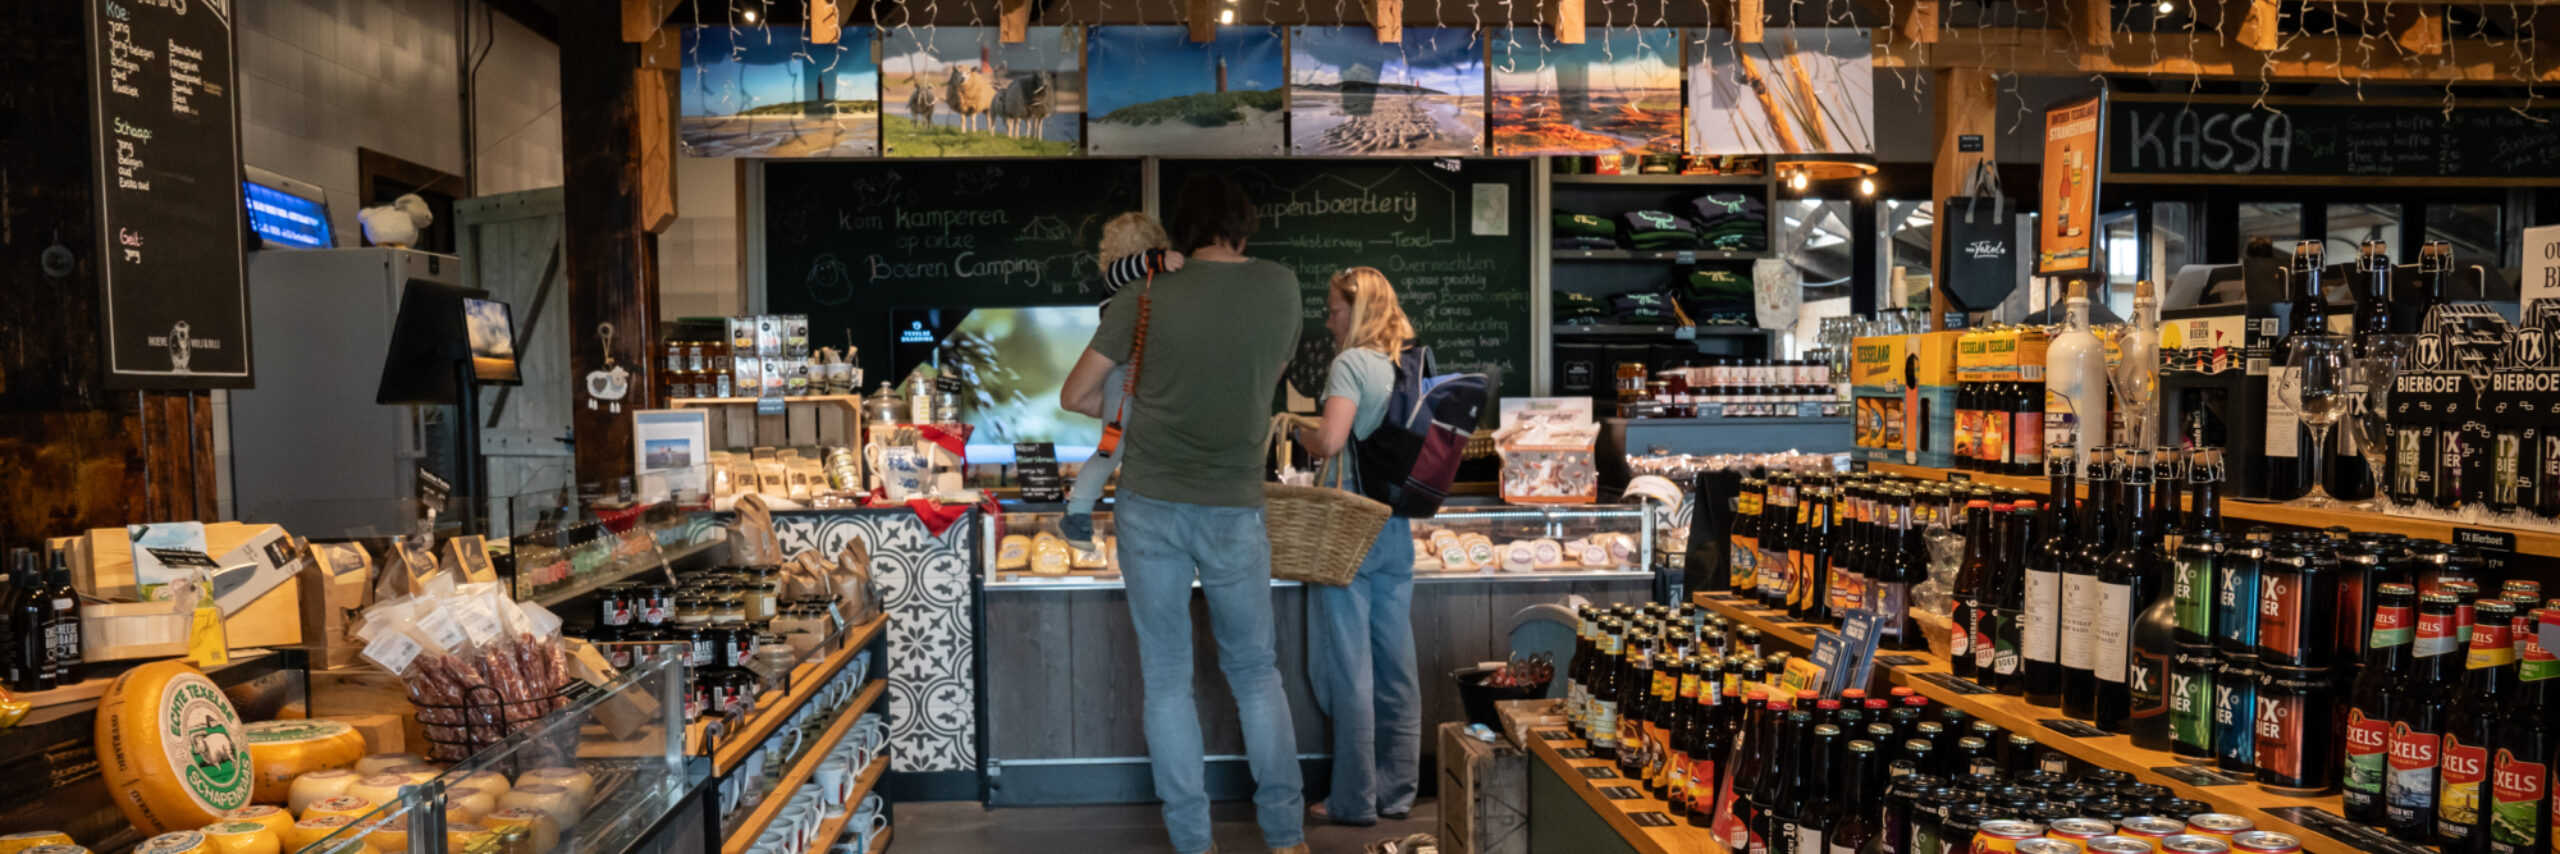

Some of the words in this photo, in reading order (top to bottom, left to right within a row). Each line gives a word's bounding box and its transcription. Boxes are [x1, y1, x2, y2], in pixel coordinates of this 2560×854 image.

[2129, 109, 2293, 174] KASSA
[925, 232, 976, 249] onze
[863, 252, 950, 284] Boeren
[954, 250, 1041, 288] Camping
[2420, 337, 2439, 366] TX
[2519, 331, 2543, 362] TX
[2397, 375, 2462, 394] BIERBOET
[2399, 429, 2421, 451] TX
[2461, 532, 2471, 542] TX
[2472, 533, 2504, 546] Bierboet
[169, 686, 189, 738] ECHTE
[189, 758, 251, 807] SCHAPENKAAS
